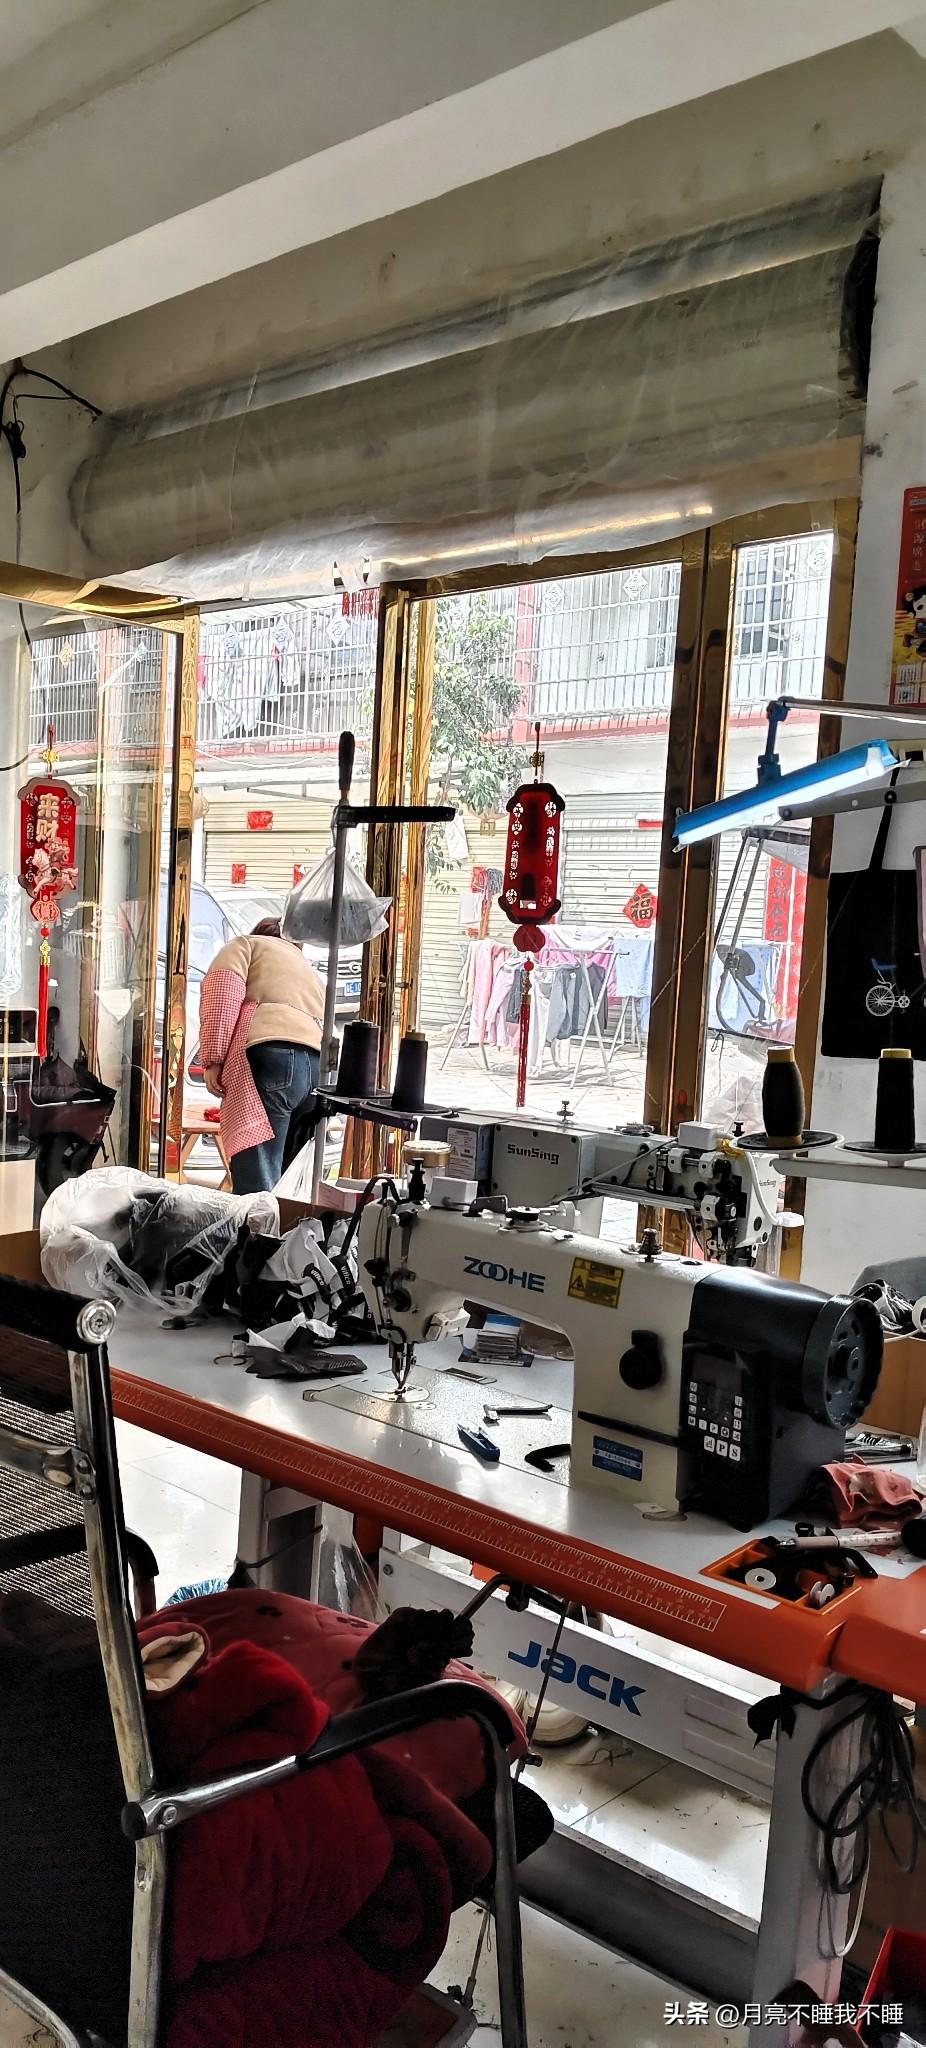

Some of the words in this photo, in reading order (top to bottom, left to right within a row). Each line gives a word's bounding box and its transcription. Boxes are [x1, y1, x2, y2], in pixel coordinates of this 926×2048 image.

[37, 793, 60, 842] 来财
[631, 892, 654, 921] 福
[507, 1144, 560, 1165] SunSing
[463, 1256, 546, 1293] ZOOHE
